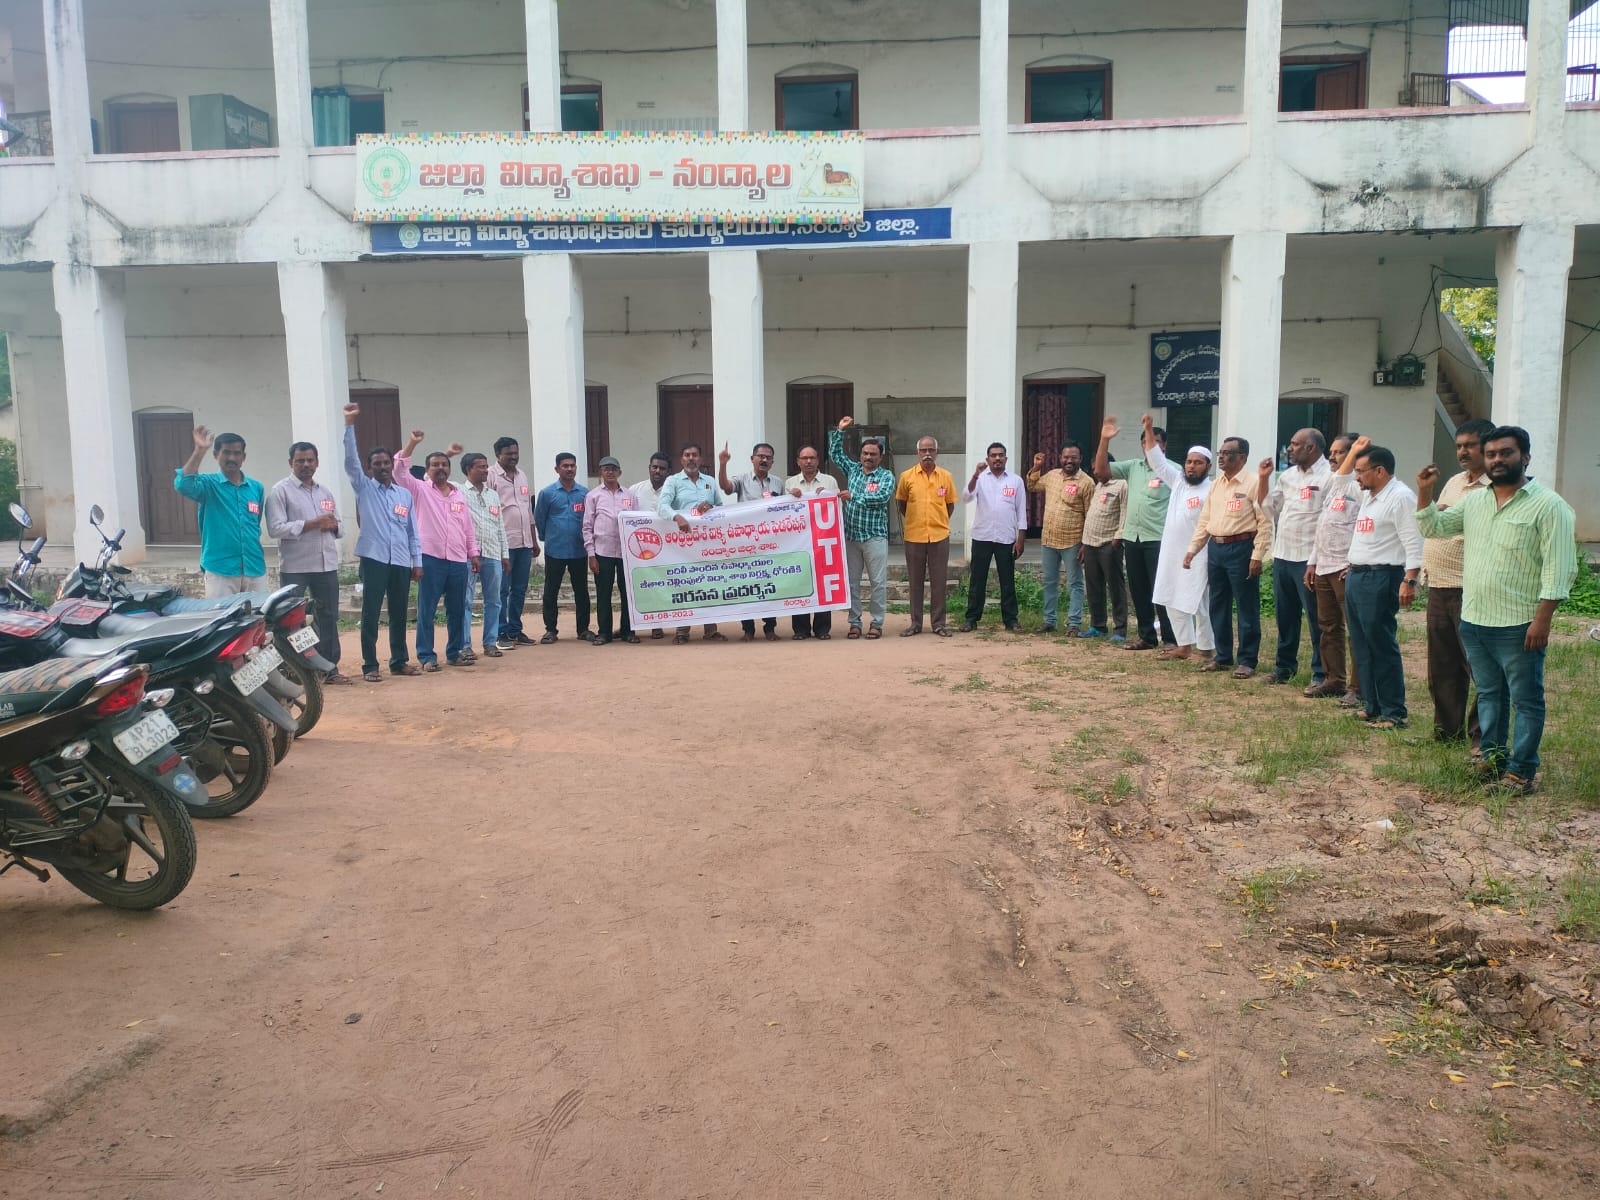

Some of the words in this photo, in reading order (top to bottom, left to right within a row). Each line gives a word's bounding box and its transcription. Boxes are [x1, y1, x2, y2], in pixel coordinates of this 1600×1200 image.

[419, 163, 485, 196] జిల్లా
[673, 158, 792, 201] నంద్యాల
[422, 225, 471, 247] జిల్లా
[1003, 488, 1015, 496] UTF
[394, 504, 408, 516] UTF
[451, 502, 463, 512] UTF
[574, 503, 584, 512] UTF
[1227, 500, 1241, 511] UTF
[727, 520, 770, 541] ఉపాధ్యాయ
[771, 515, 807, 534] ఫెడరేషన్
[1358, 519, 1373, 532] UTF
[701, 547, 736, 557] నంద్యాల
[758, 542, 778, 551] శాఖ
[813, 501, 841, 602] UTF
[720, 559, 774, 571] ఉపాధ్యాయుల
[671, 588, 719, 605] నిరసన
[722, 582, 777, 601] ప్రదర్శన
[643, 610, 694, 621] 04-08-2023
[128, 718, 160, 742] AP21
